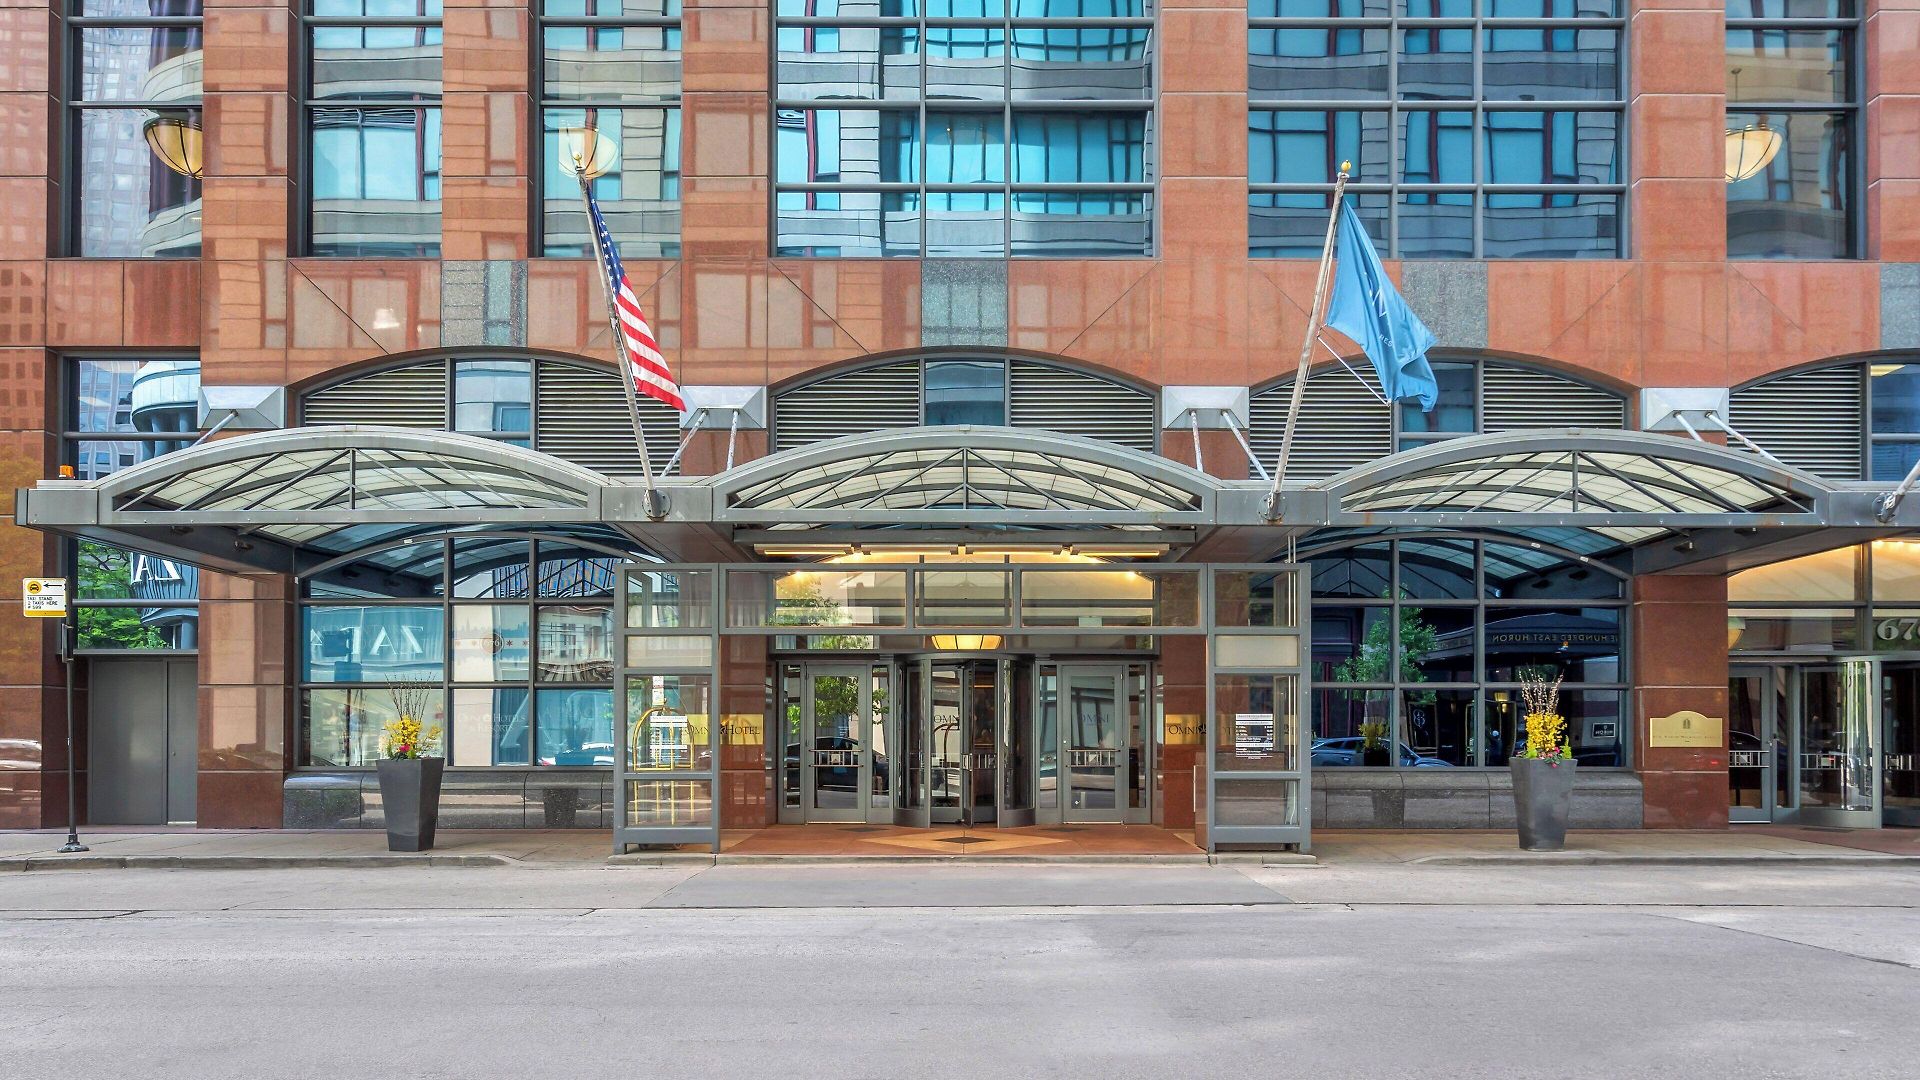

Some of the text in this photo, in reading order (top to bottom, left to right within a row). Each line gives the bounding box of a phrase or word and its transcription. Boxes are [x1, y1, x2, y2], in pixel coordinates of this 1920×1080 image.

[1877, 618, 1920, 640] 67
[725, 724, 760, 735] HOTEL
[1168, 724, 1201, 735] OMNI
